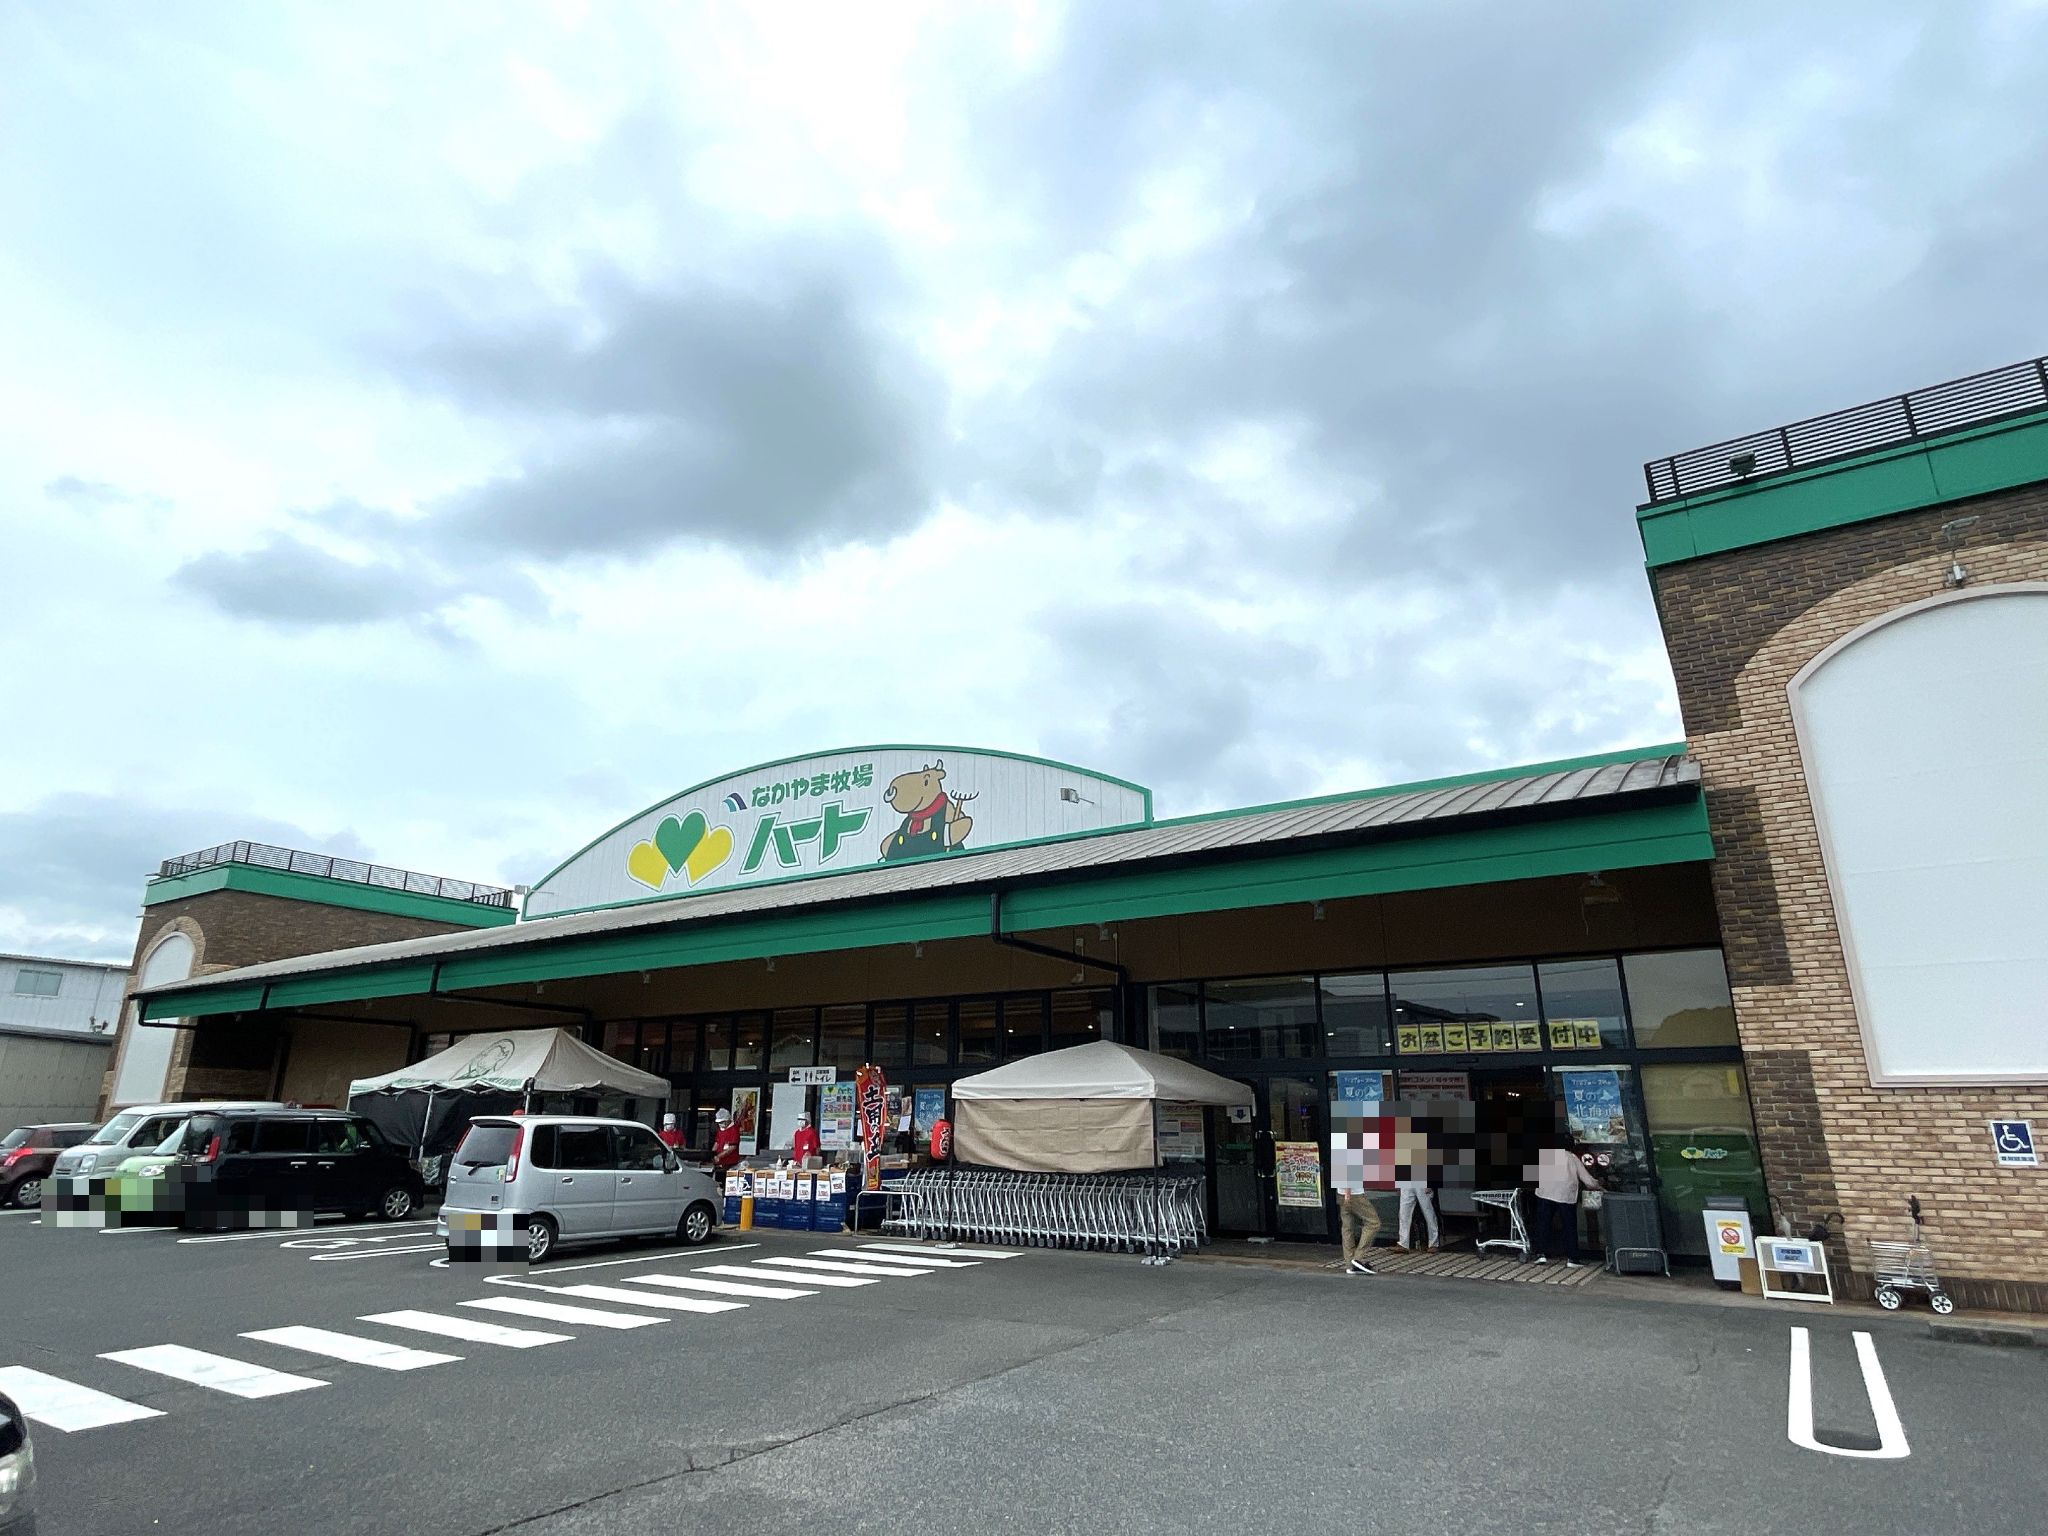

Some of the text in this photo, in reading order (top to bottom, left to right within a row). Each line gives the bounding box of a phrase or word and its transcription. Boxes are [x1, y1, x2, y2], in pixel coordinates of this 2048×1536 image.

[752, 763, 873, 807] なかやま牧場
[739, 800, 873, 875] ハート
